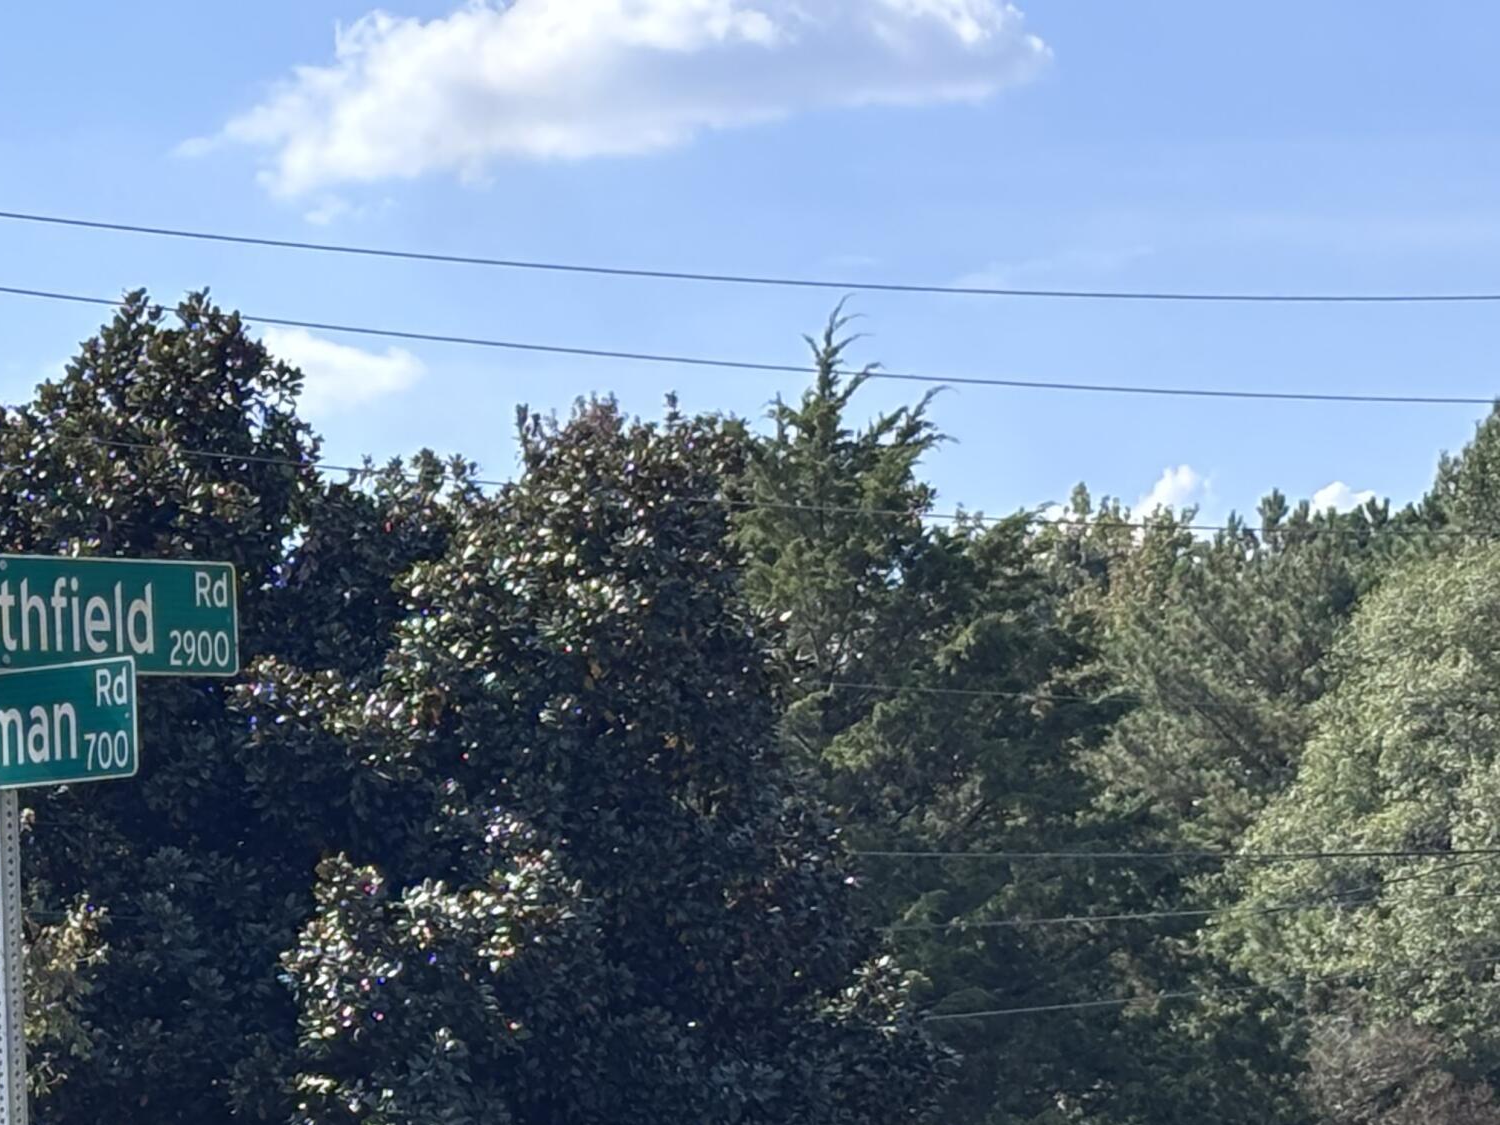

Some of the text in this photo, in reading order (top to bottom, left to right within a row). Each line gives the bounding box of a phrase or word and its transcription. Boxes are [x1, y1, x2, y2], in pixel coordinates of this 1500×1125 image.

[195, 571, 228, 608] Rd
[169, 629, 230, 668] 2900
[95, 665, 128, 708] Rd
[84, 729, 130, 772] 700
